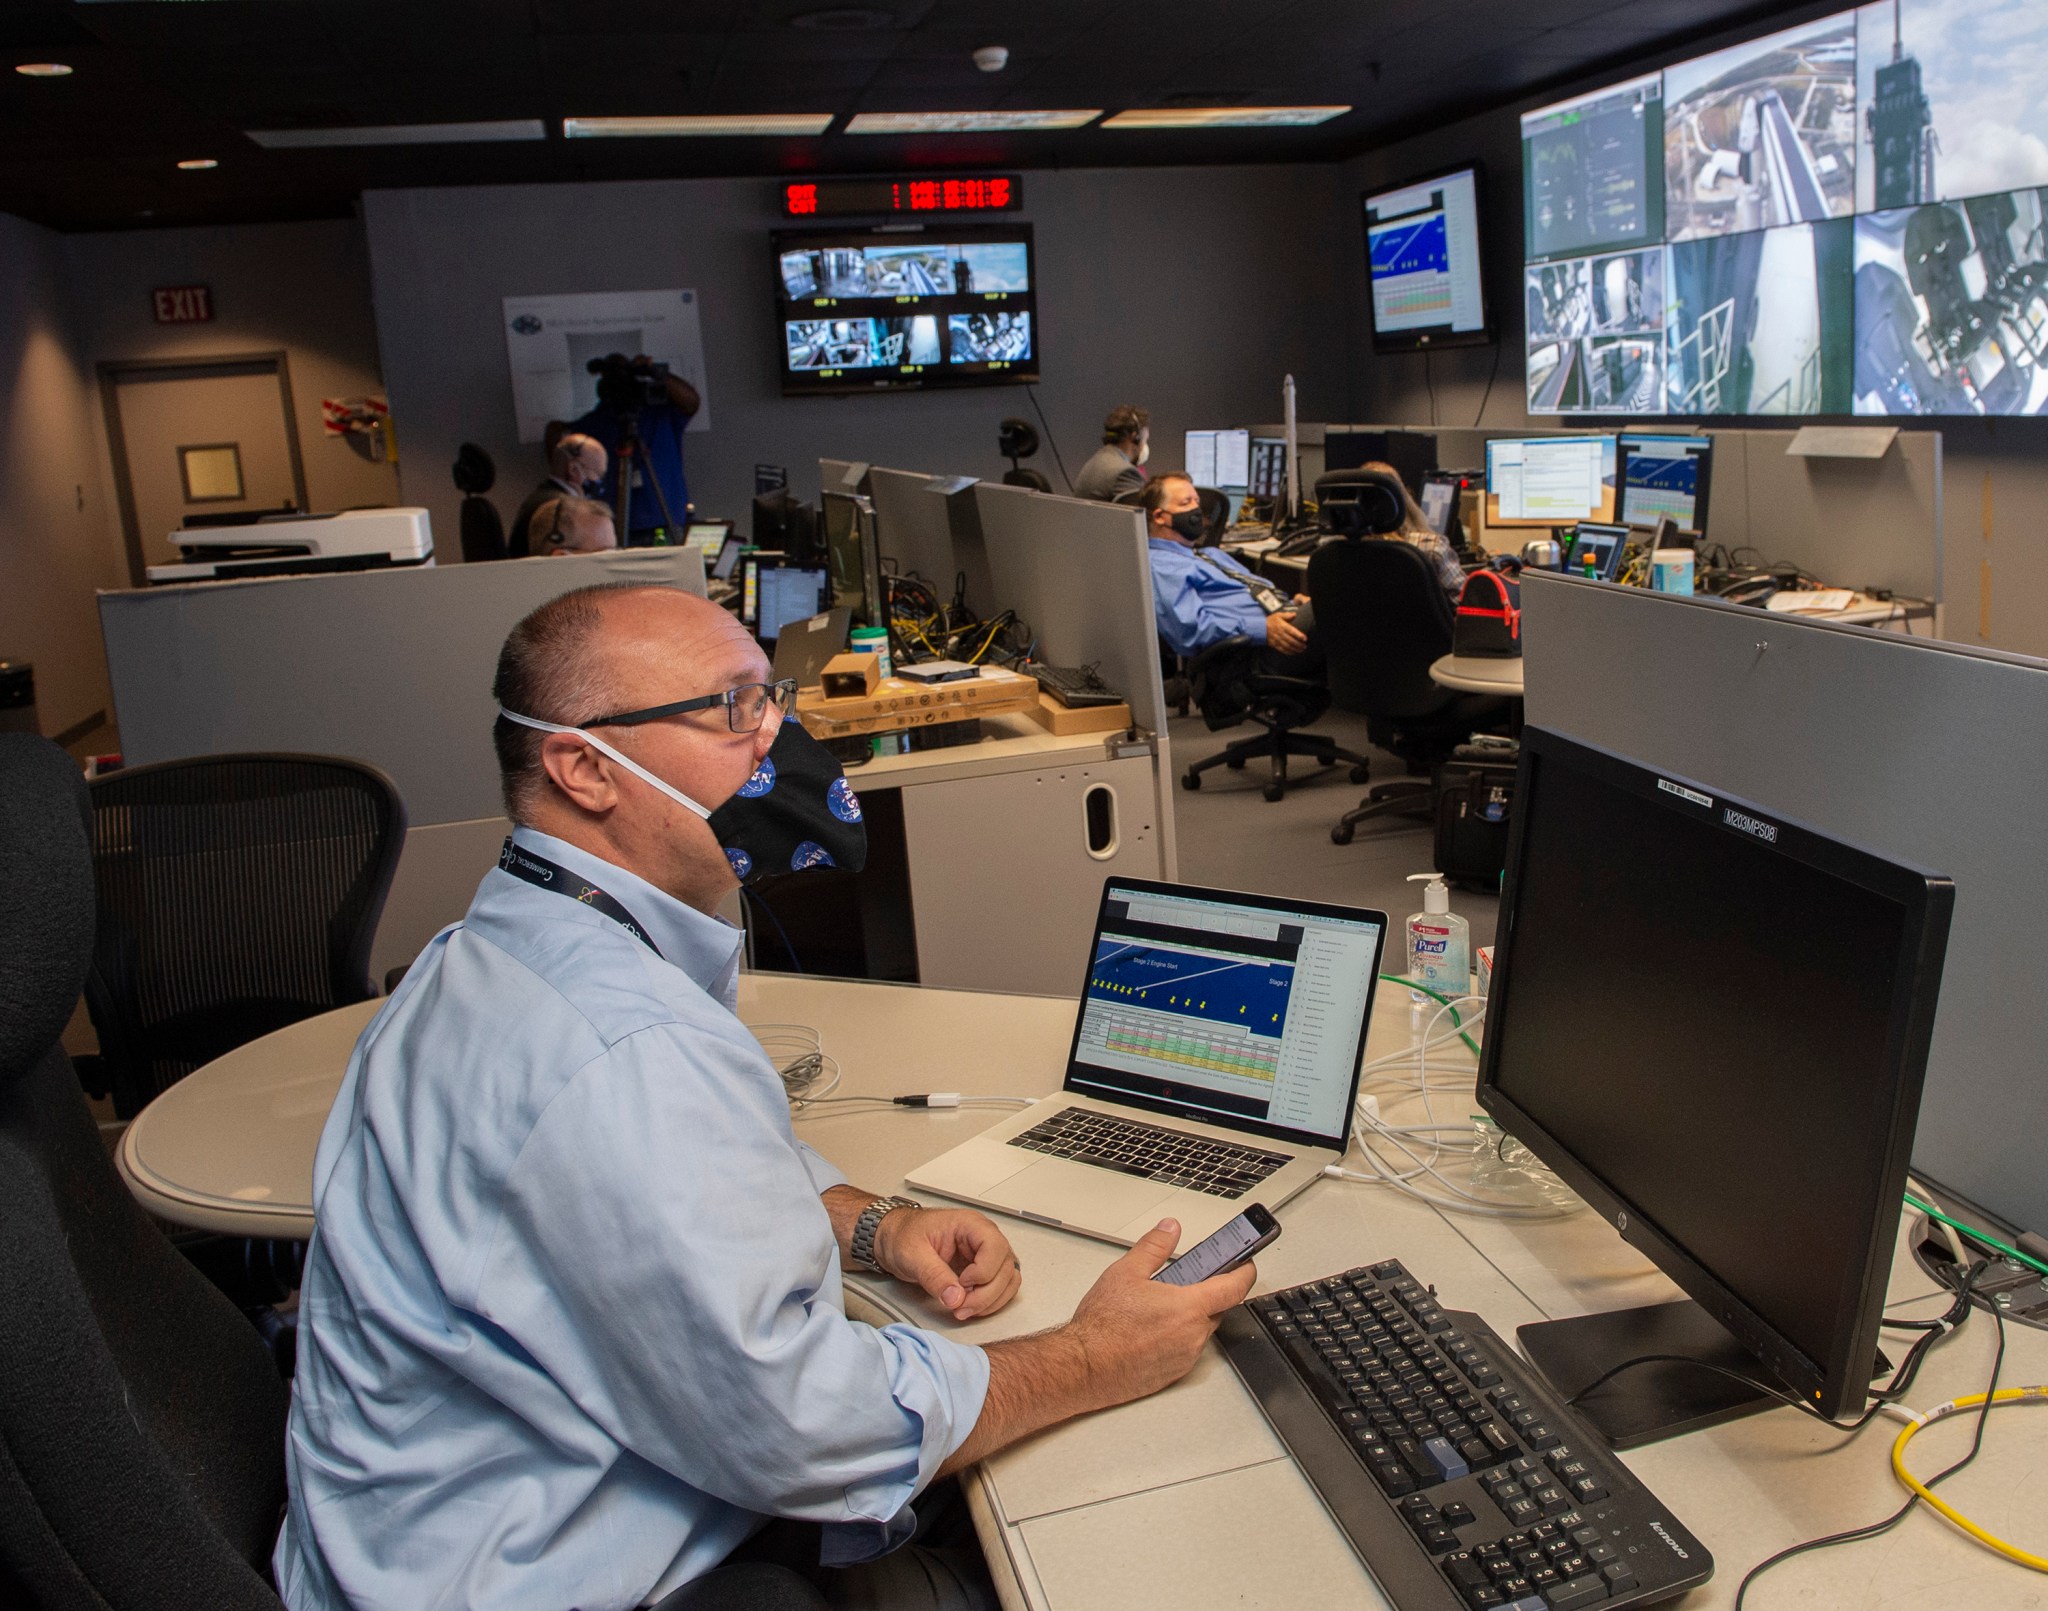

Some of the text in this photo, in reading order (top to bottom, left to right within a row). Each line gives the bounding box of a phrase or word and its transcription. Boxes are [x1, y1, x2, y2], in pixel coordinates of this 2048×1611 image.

[155, 288, 206, 322] EXIT
[839, 778, 860, 820] NASA
[1725, 809, 1775, 841] M203MPS08
[1418, 940, 1444, 953] Purell
[1133, 956, 1146, 966] Stage
[1150, 960, 1166, 969] Engine
[1166, 961, 1178, 970] Start
[1268, 977, 1283, 988] Stage
[1648, 1521, 1689, 1559] lenovo
